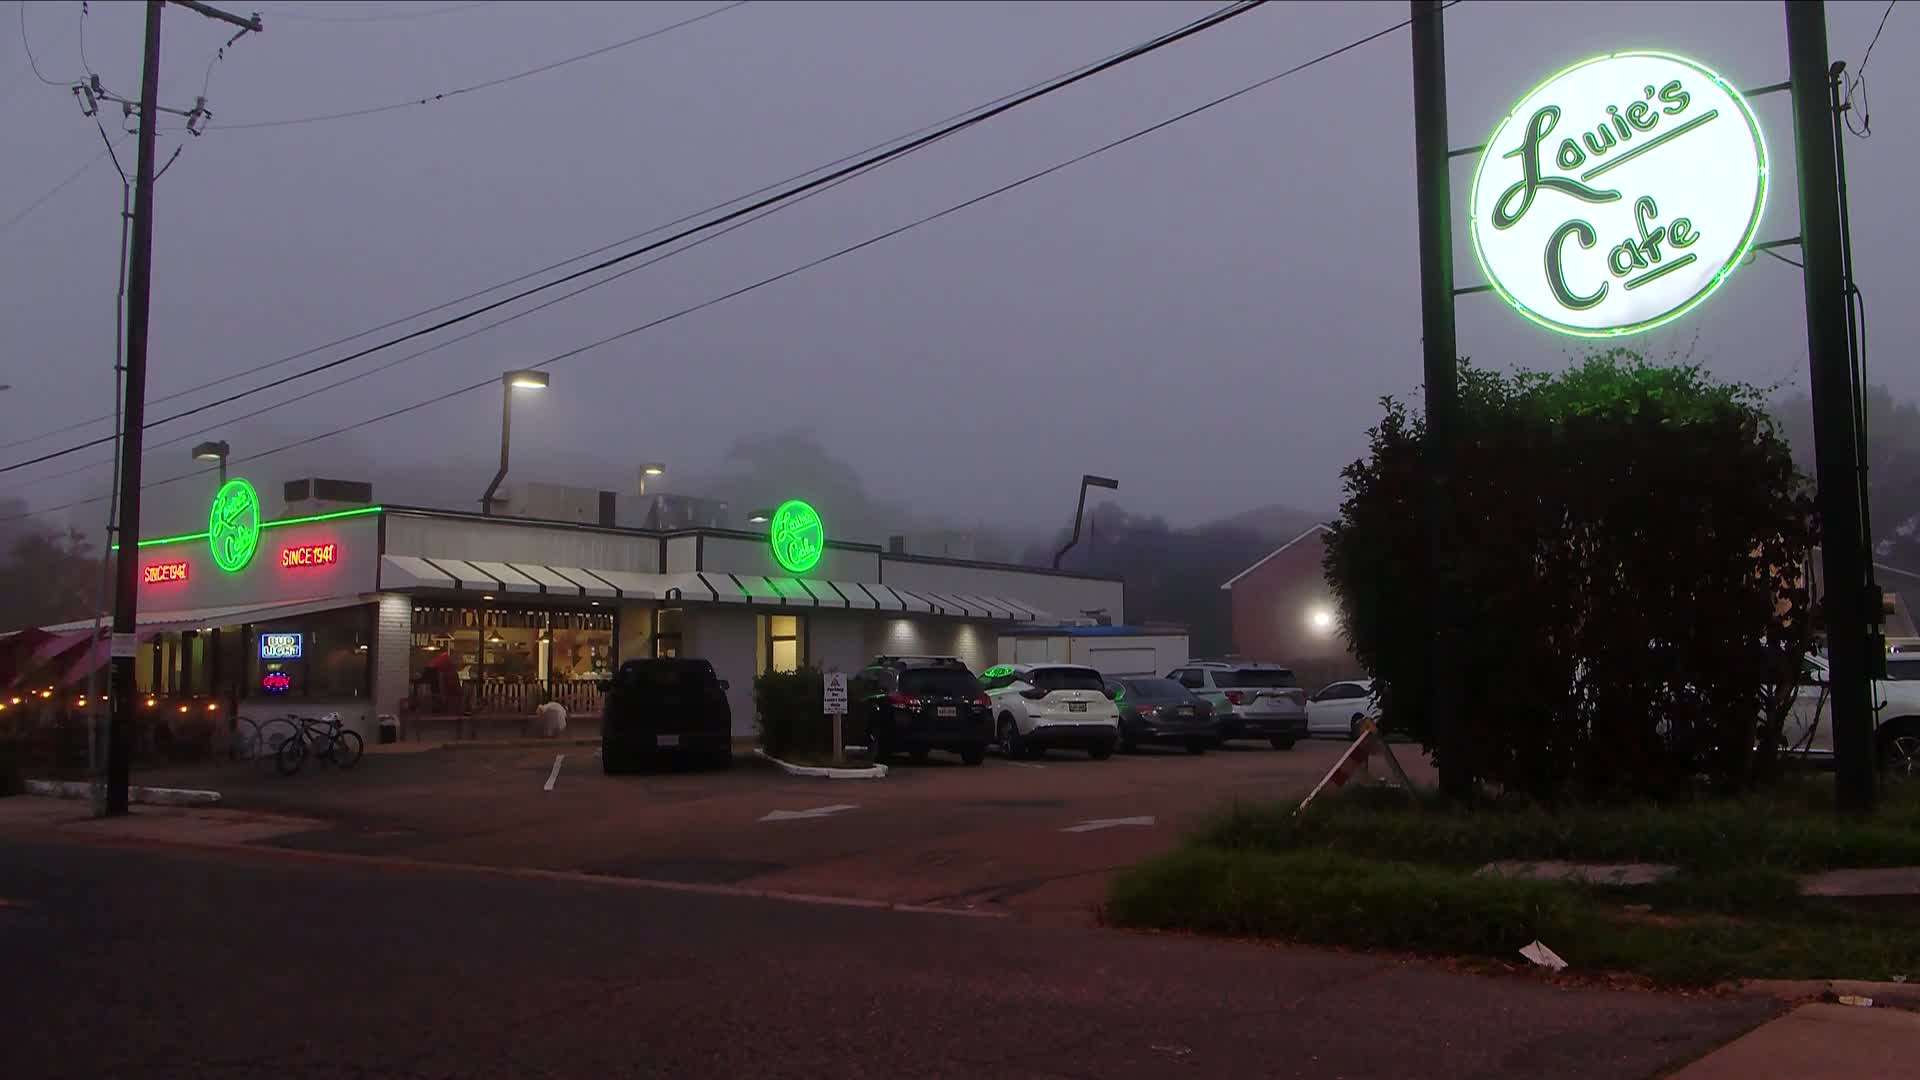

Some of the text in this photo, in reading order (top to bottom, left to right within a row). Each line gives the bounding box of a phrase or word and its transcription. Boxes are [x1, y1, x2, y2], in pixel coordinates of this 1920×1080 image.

[1492, 81, 1691, 230] Louie's
[1544, 195, 1700, 310] Cafe
[282, 544, 334, 566] SINCE 1941
[144, 565, 169, 582] SINCE
[267, 636, 295, 646] BUD
[263, 645, 299, 656] LIGHT
[263, 675, 289, 686] OPEN
